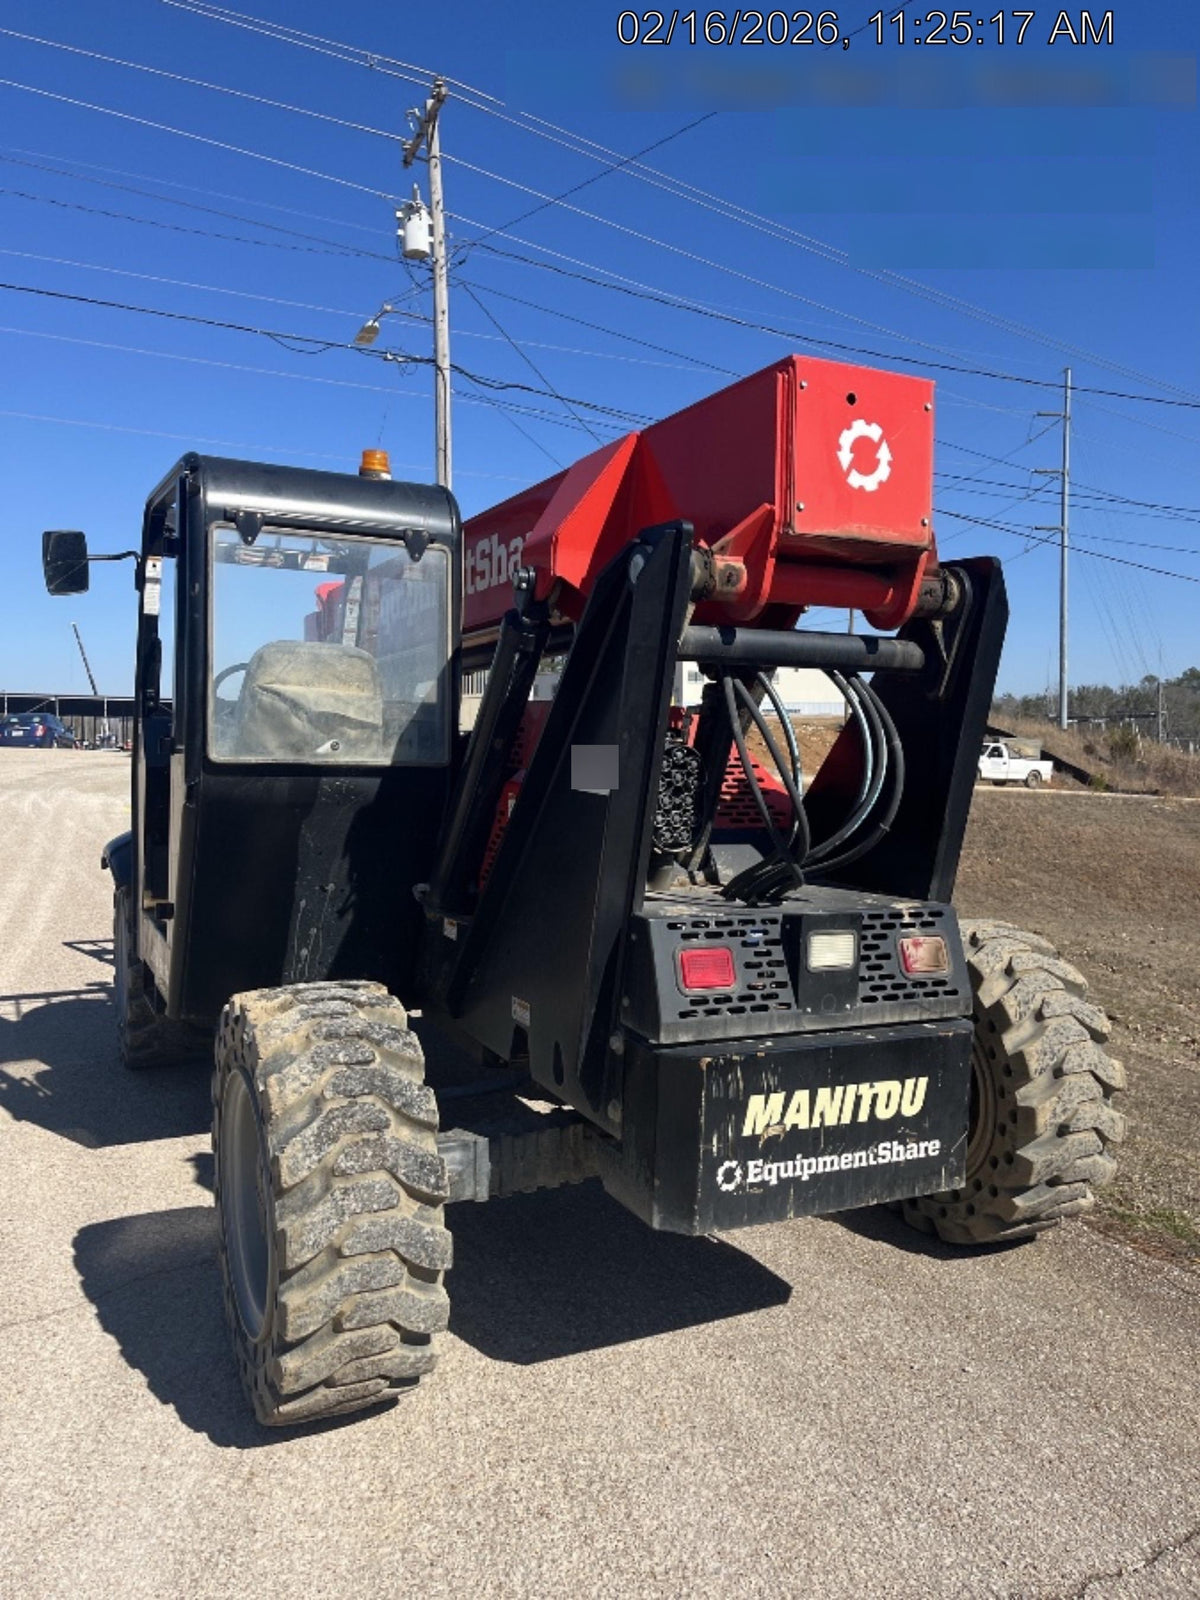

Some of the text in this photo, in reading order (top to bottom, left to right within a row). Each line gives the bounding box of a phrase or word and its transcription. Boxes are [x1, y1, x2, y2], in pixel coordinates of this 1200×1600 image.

[466, 531, 534, 594] tSha
[741, 1077, 929, 1137] MANITOU
[746, 1138, 941, 1186] EquipmentShare
